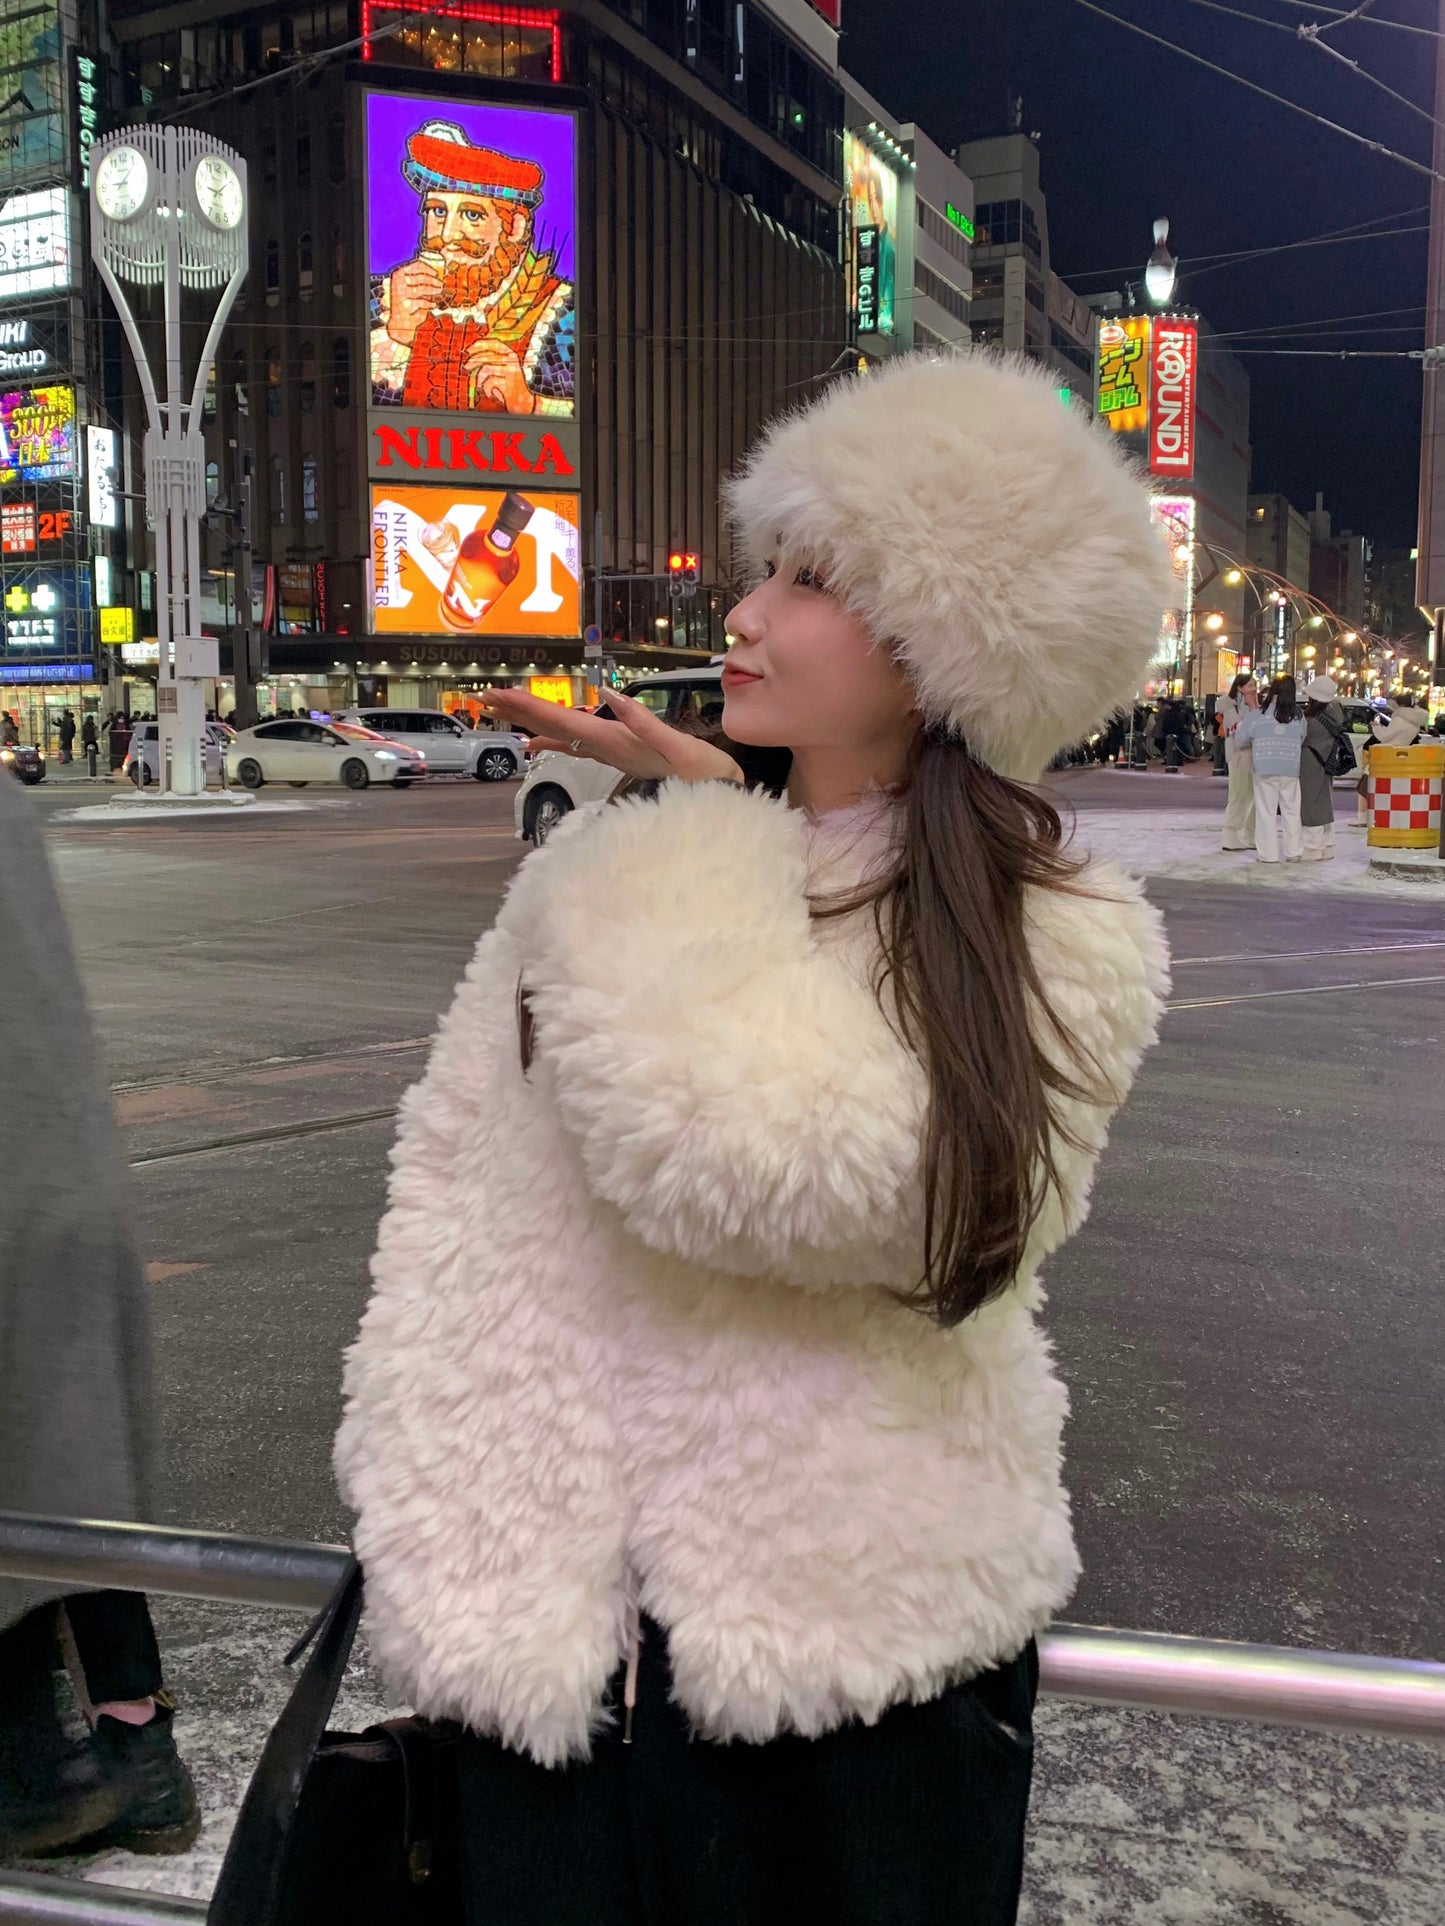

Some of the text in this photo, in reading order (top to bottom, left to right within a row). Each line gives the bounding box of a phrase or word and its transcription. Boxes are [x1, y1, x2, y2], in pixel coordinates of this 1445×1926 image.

[1156, 331, 1189, 465] ROUND1
[373, 424, 575, 475] NIKKA
[39, 512, 69, 540] 2F
[393, 512, 408, 574] NIKKA
[374, 511, 390, 607] FRONTIER
[8, 619, 55, 636] サツドラ
[400, 645, 552, 663] SUSUKINO BLD.
